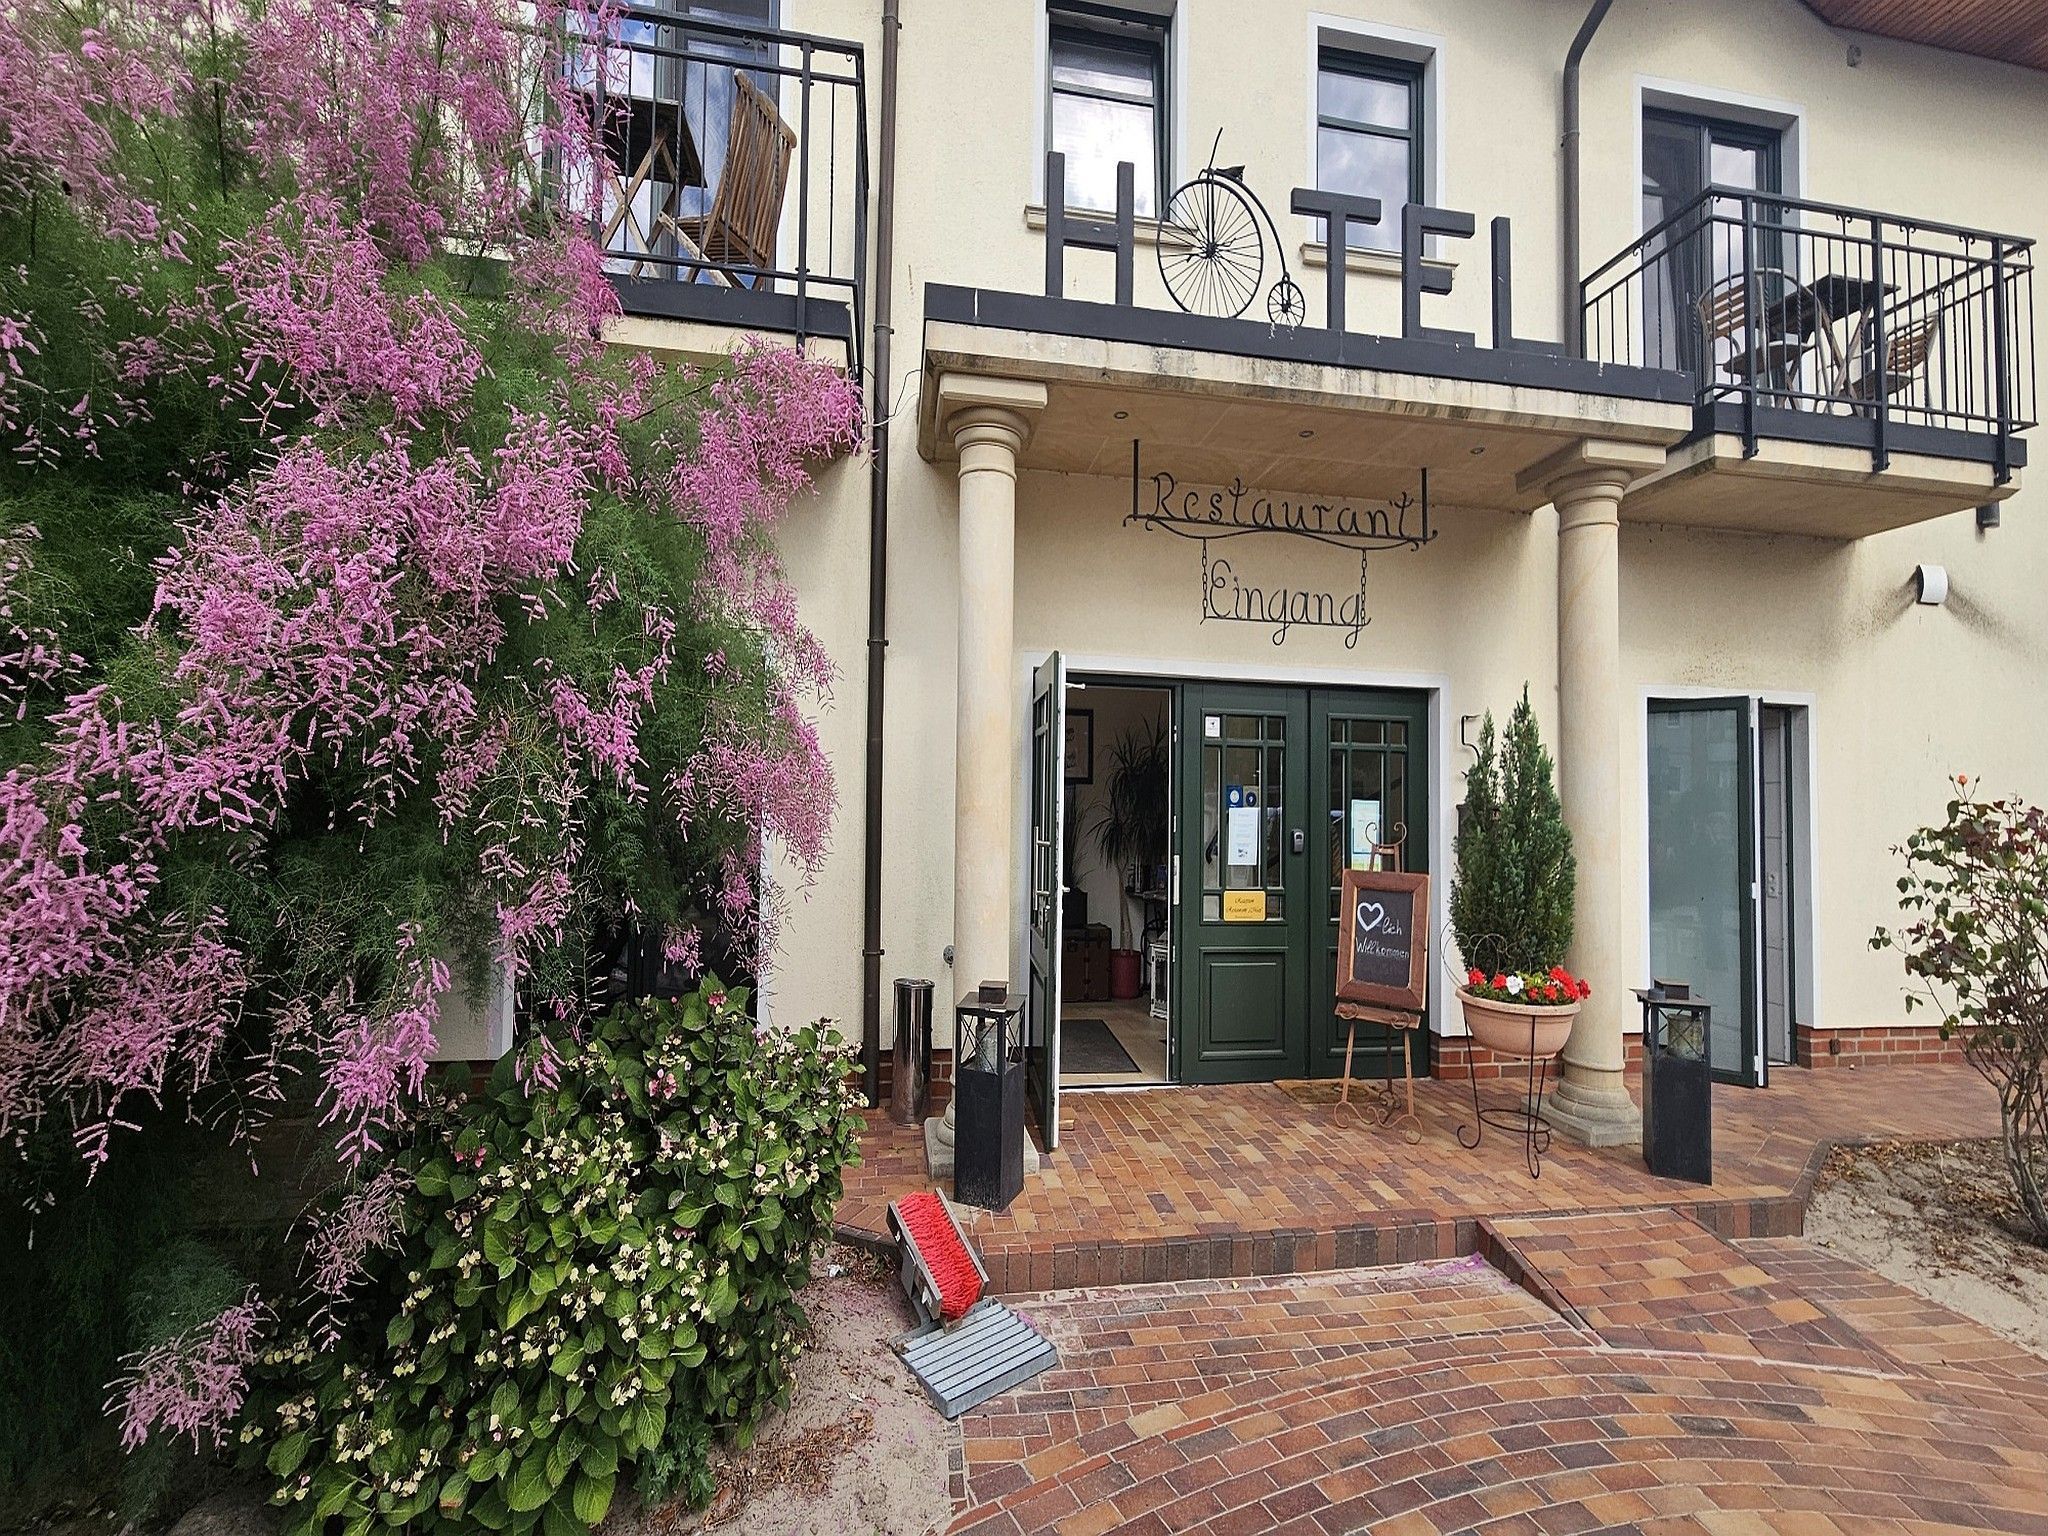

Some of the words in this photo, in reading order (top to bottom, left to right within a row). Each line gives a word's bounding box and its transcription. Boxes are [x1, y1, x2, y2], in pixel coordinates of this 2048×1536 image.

[1046, 150, 1567, 350] HOTEL
[1150, 471, 1414, 538] Restaurant
[1209, 559, 1363, 649] Eingang
[1355, 936, 1410, 960] Willkommen
